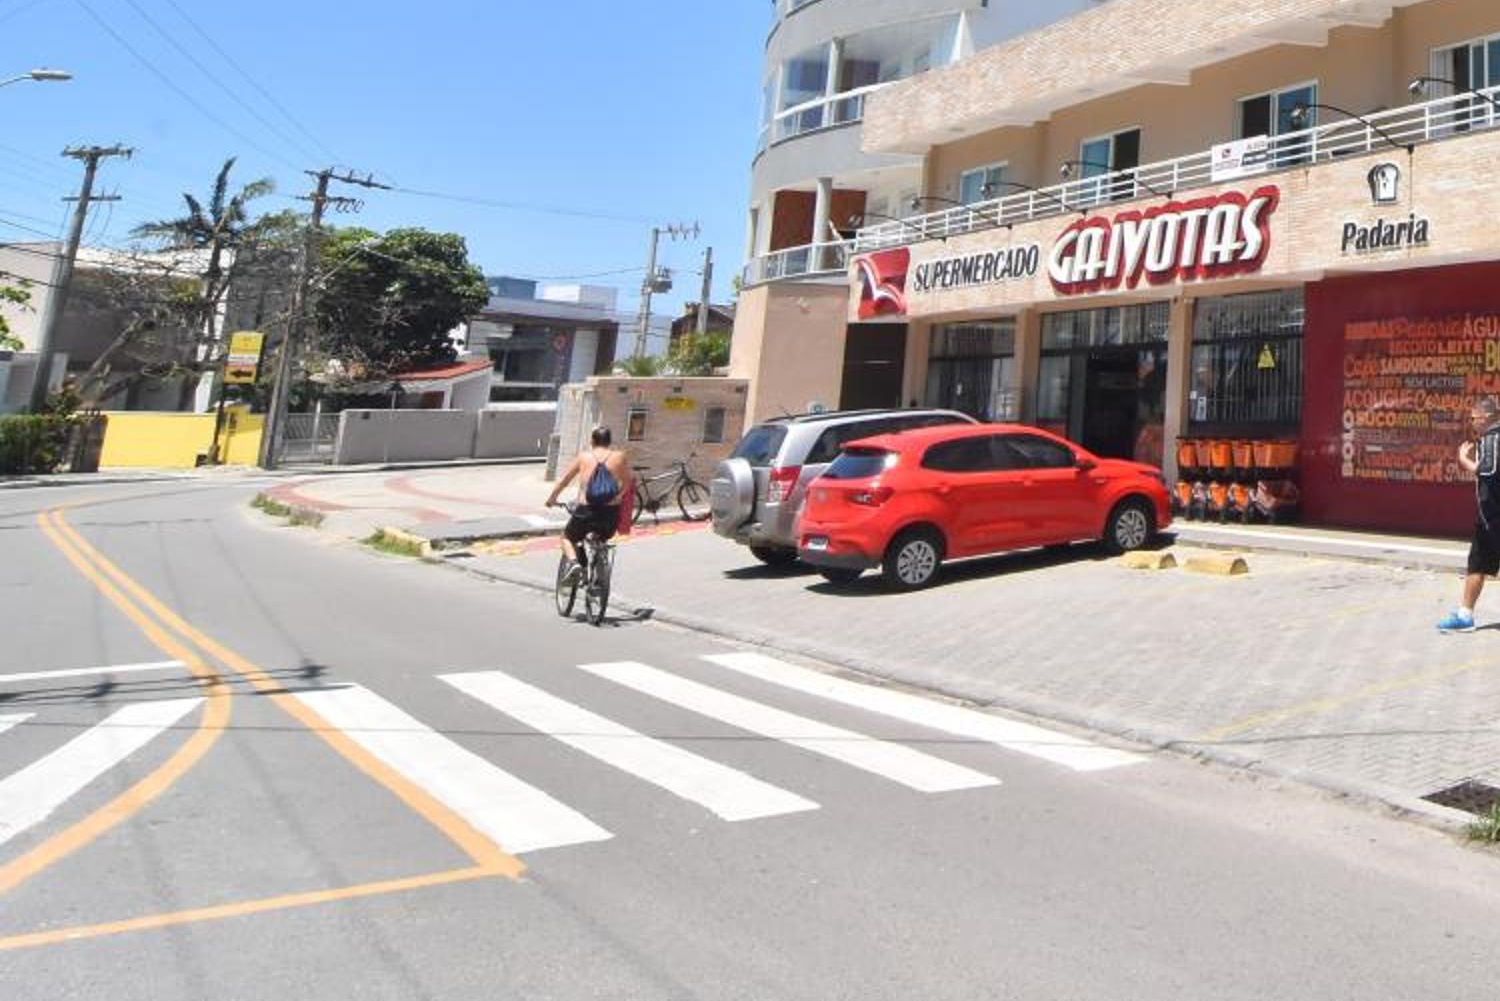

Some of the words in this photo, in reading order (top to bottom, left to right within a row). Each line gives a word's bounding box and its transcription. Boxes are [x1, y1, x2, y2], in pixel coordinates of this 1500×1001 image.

[912, 243, 1040, 292] SUPERMERCADO
[1047, 196, 1267, 285] GAIVOTAS
[1341, 212, 1430, 252] Padaria
[1438, 340, 1483, 354] LEITE
